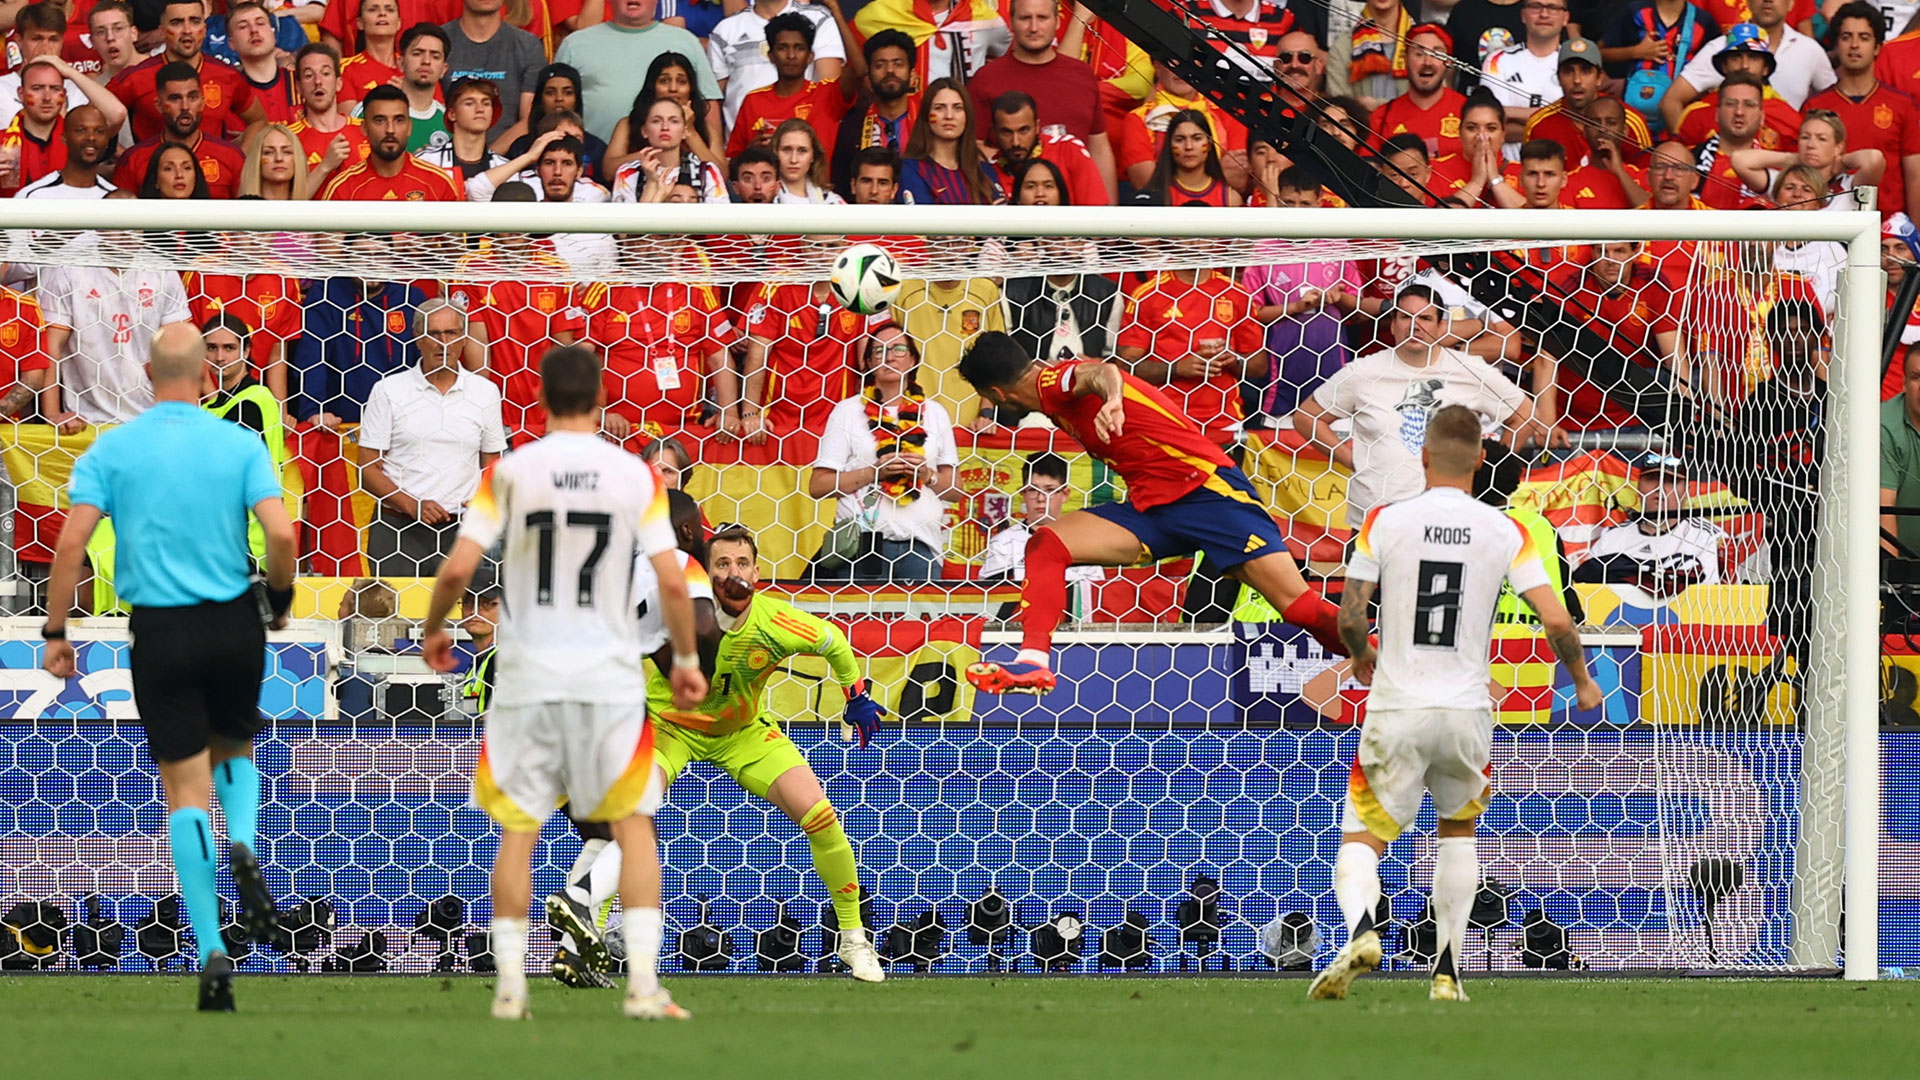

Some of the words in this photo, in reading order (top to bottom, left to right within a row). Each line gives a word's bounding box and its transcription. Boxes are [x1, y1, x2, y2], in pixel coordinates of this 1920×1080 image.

[552, 472, 600, 490] WIRTZ
[1424, 525, 1471, 545] KROOS
[525, 509, 611, 607] 17
[1413, 559, 1466, 652] 8
[720, 672, 732, 696] 1
